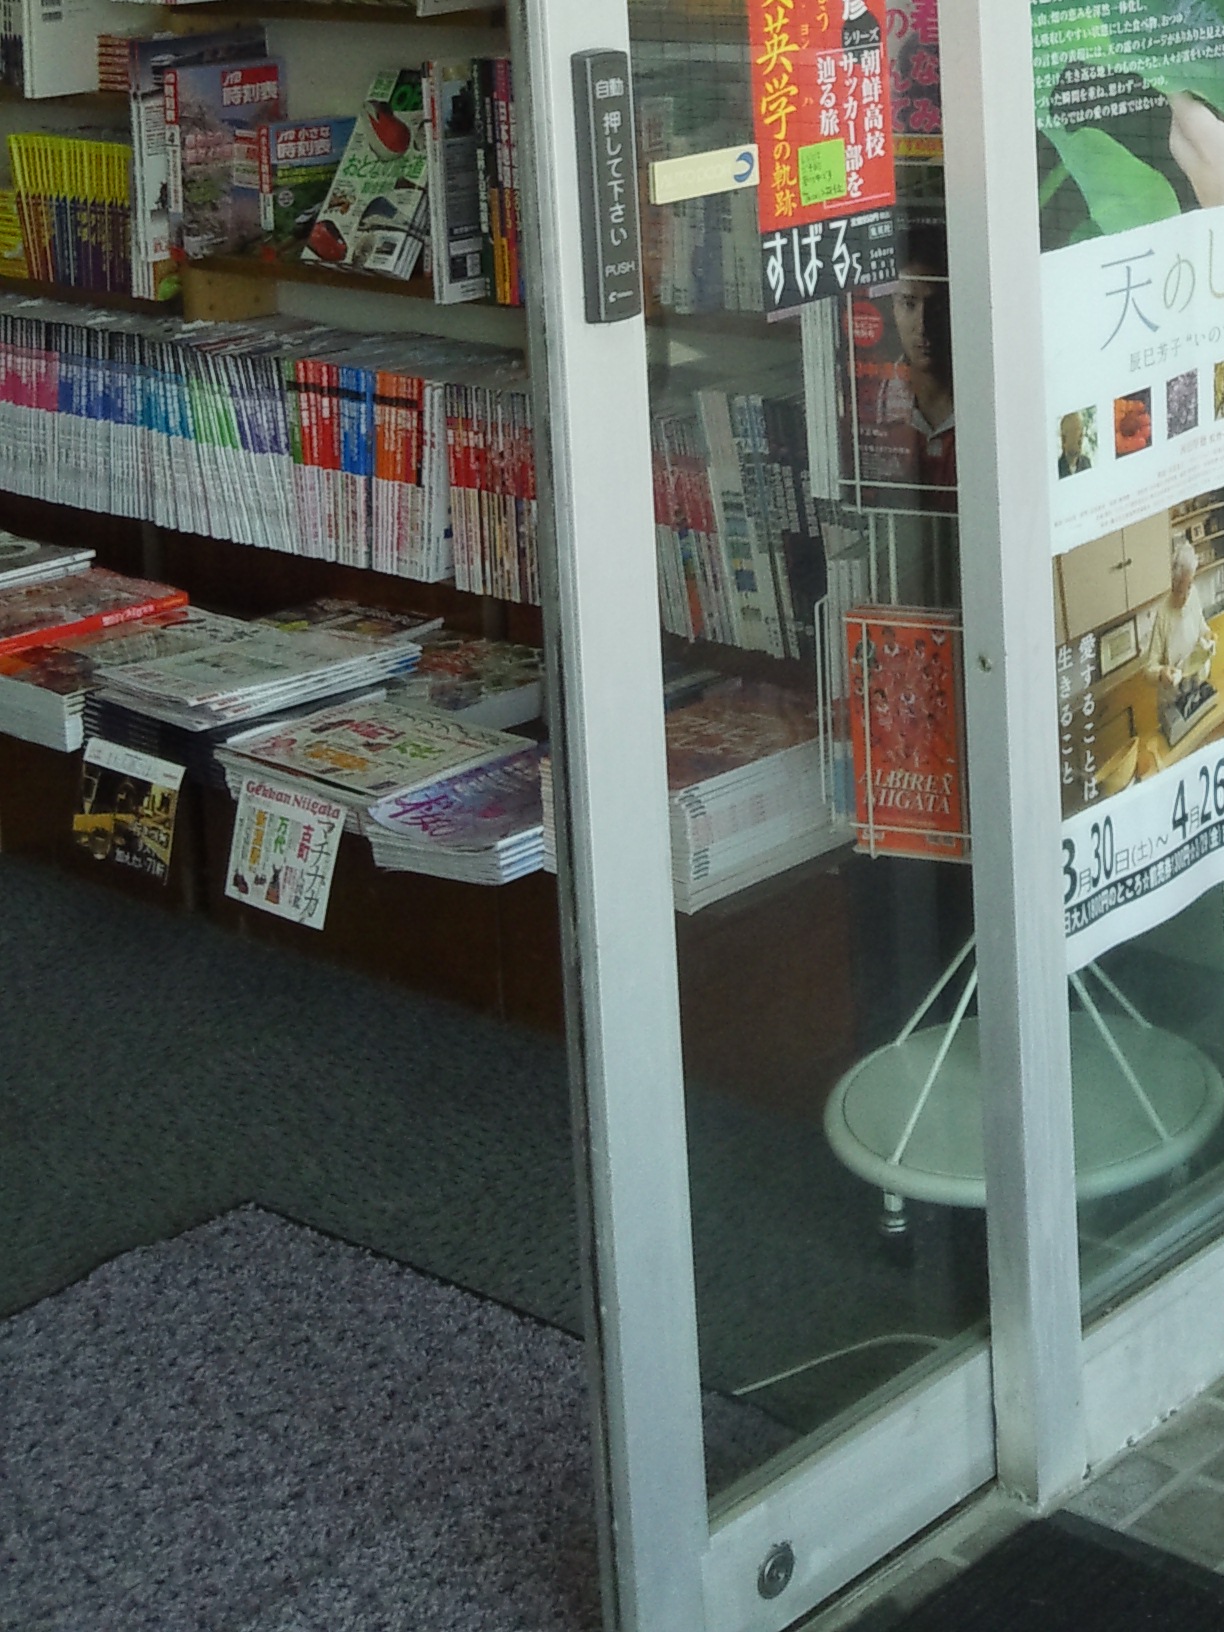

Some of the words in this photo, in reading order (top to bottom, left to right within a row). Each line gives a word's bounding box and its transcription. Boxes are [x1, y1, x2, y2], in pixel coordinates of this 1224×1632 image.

[843, 26, 880, 47] シリーズ
[222, 81, 278, 107] 時刻表
[595, 79, 624, 99] 自動
[816, 56, 840, 137] 辿る旅
[839, 53, 865, 198] サッカー部を
[860, 49, 887, 160] 朝鮮高校
[601, 111, 629, 247] 押して下さい
[605, 260, 636, 277] PUSH
[763, 220, 850, 305] すばる
[1057, 644, 1074, 785] 生きること
[1078, 632, 1099, 802] 愛することは
